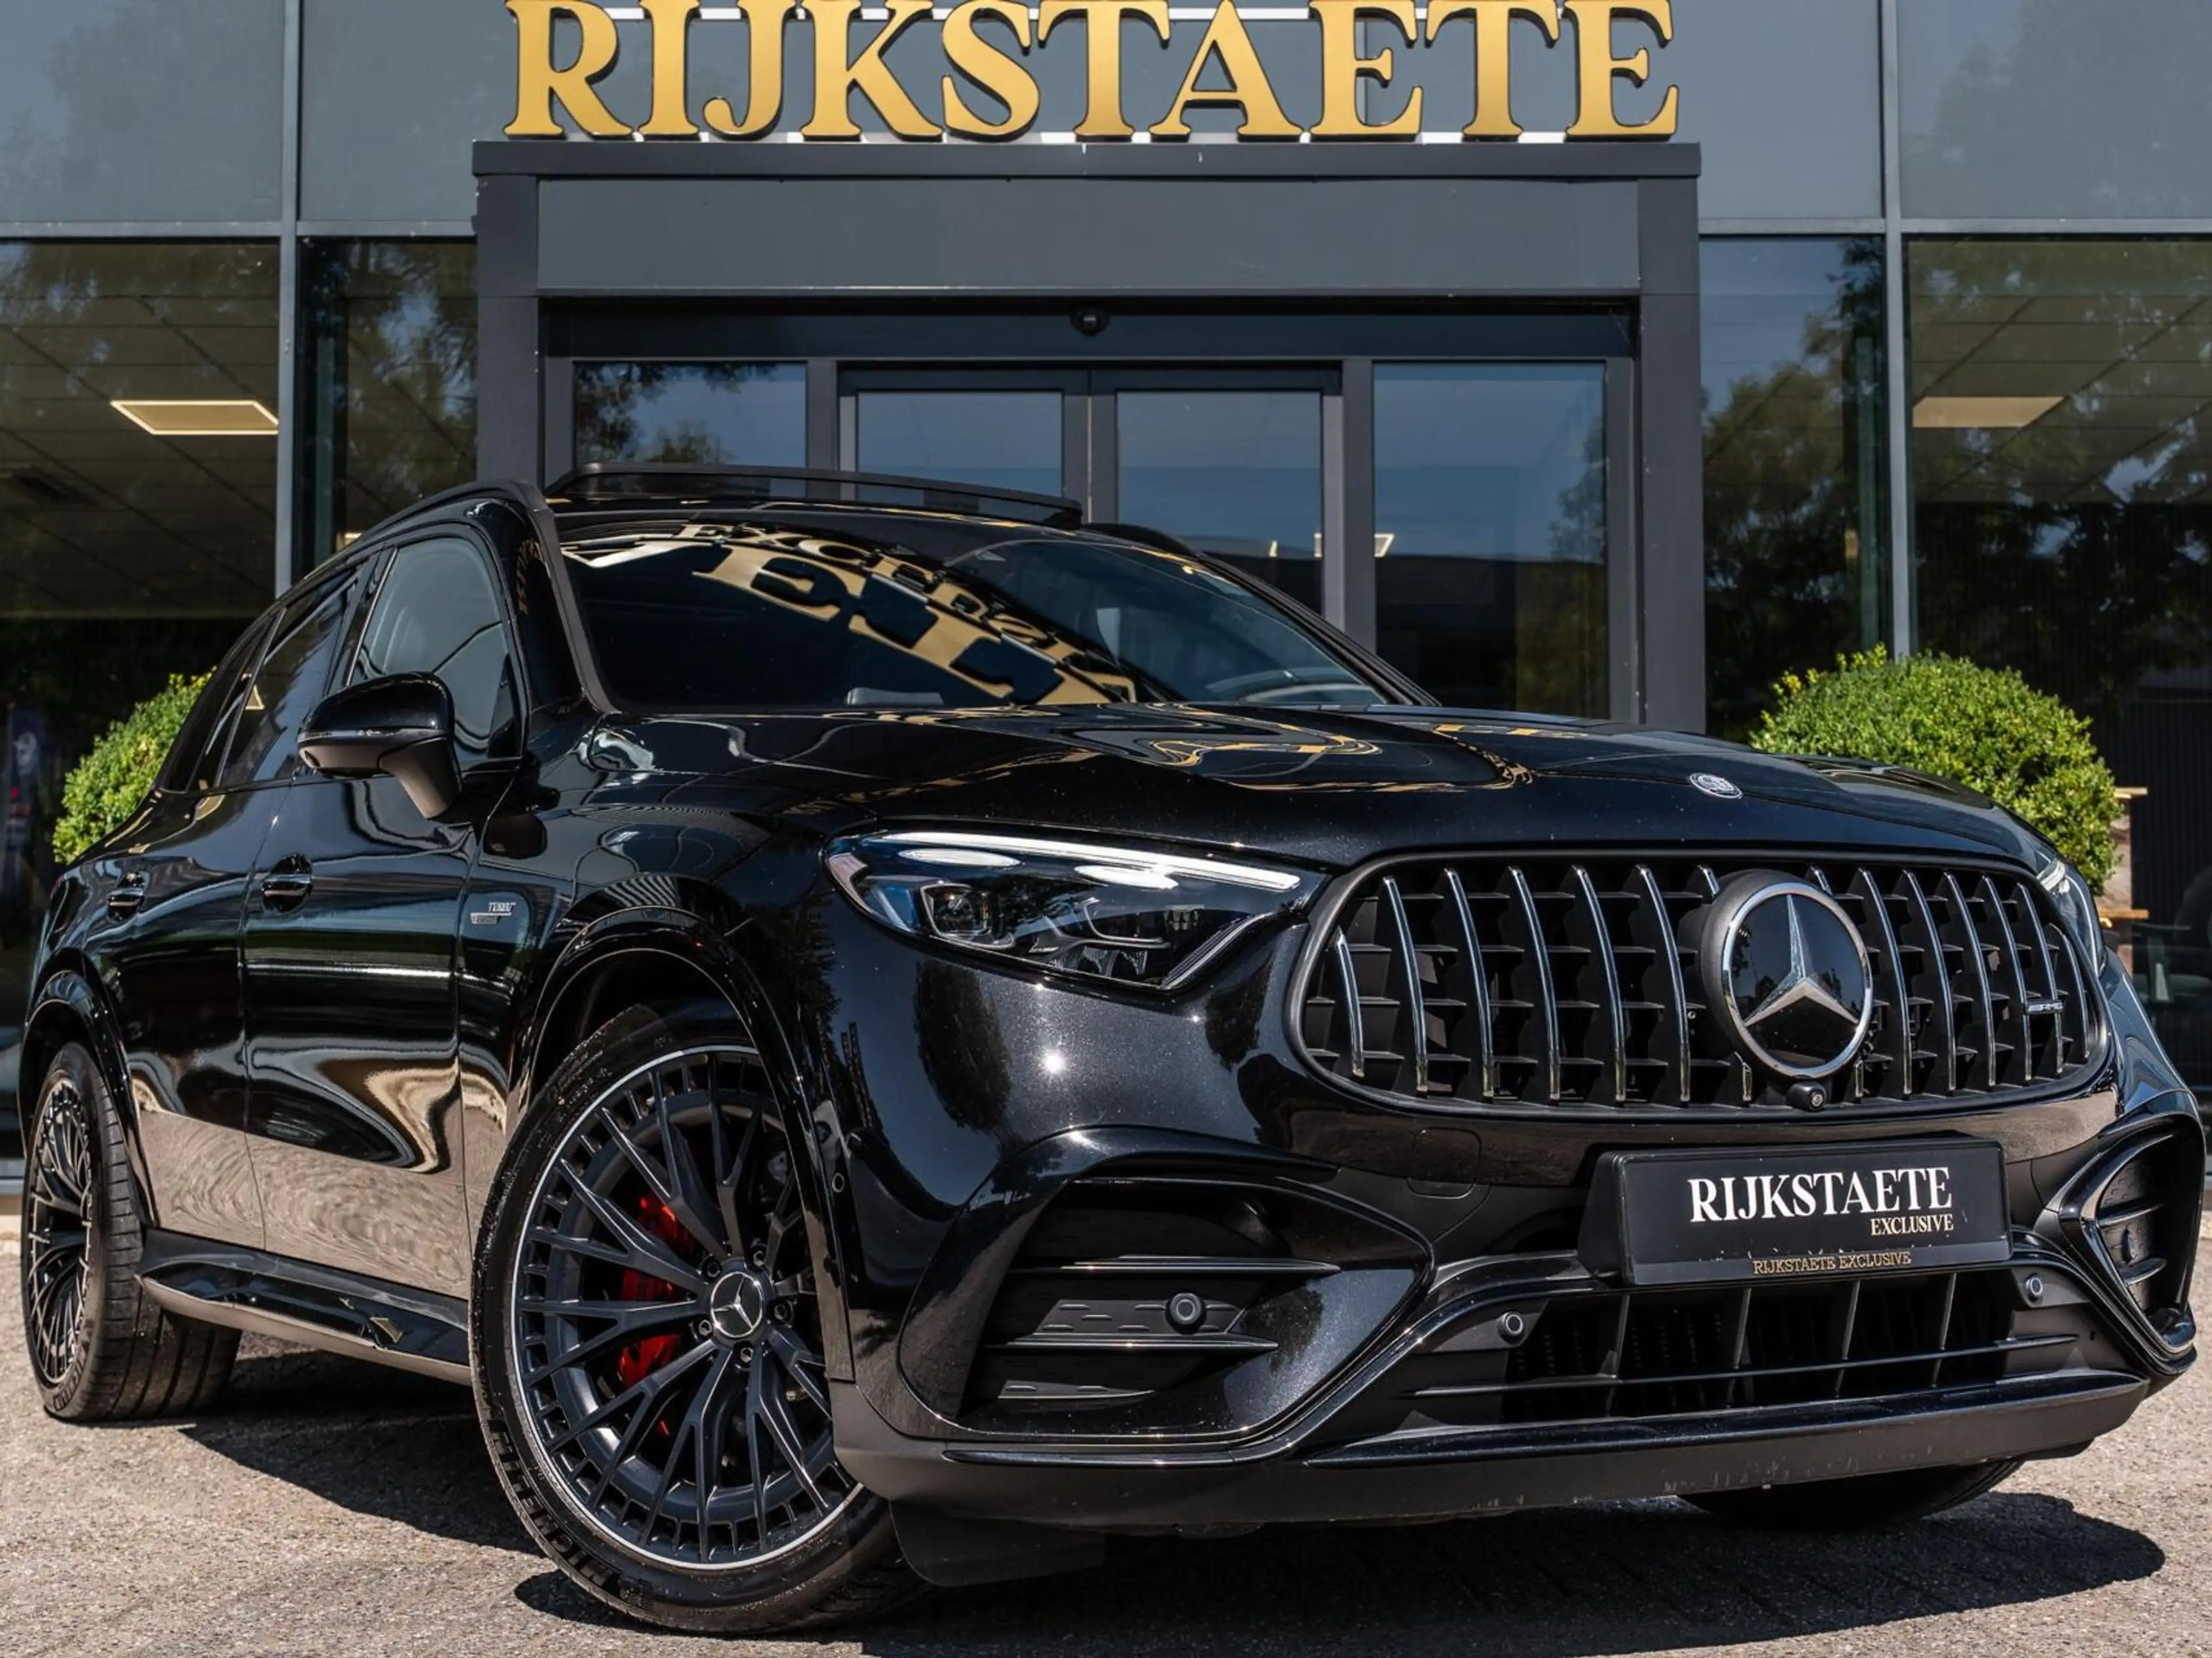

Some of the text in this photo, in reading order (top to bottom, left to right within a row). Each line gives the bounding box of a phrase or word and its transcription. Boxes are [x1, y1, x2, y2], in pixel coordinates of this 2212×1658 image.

[504, 0, 1679, 139] RIJKSTAETE
[1688, 1167, 1952, 1222] RIJKSTAETE
[1870, 1213, 1953, 1235] EXCLUSIVE
[1753, 1251, 1911, 1274] RIJKSTAETE EXCLUSIVE
